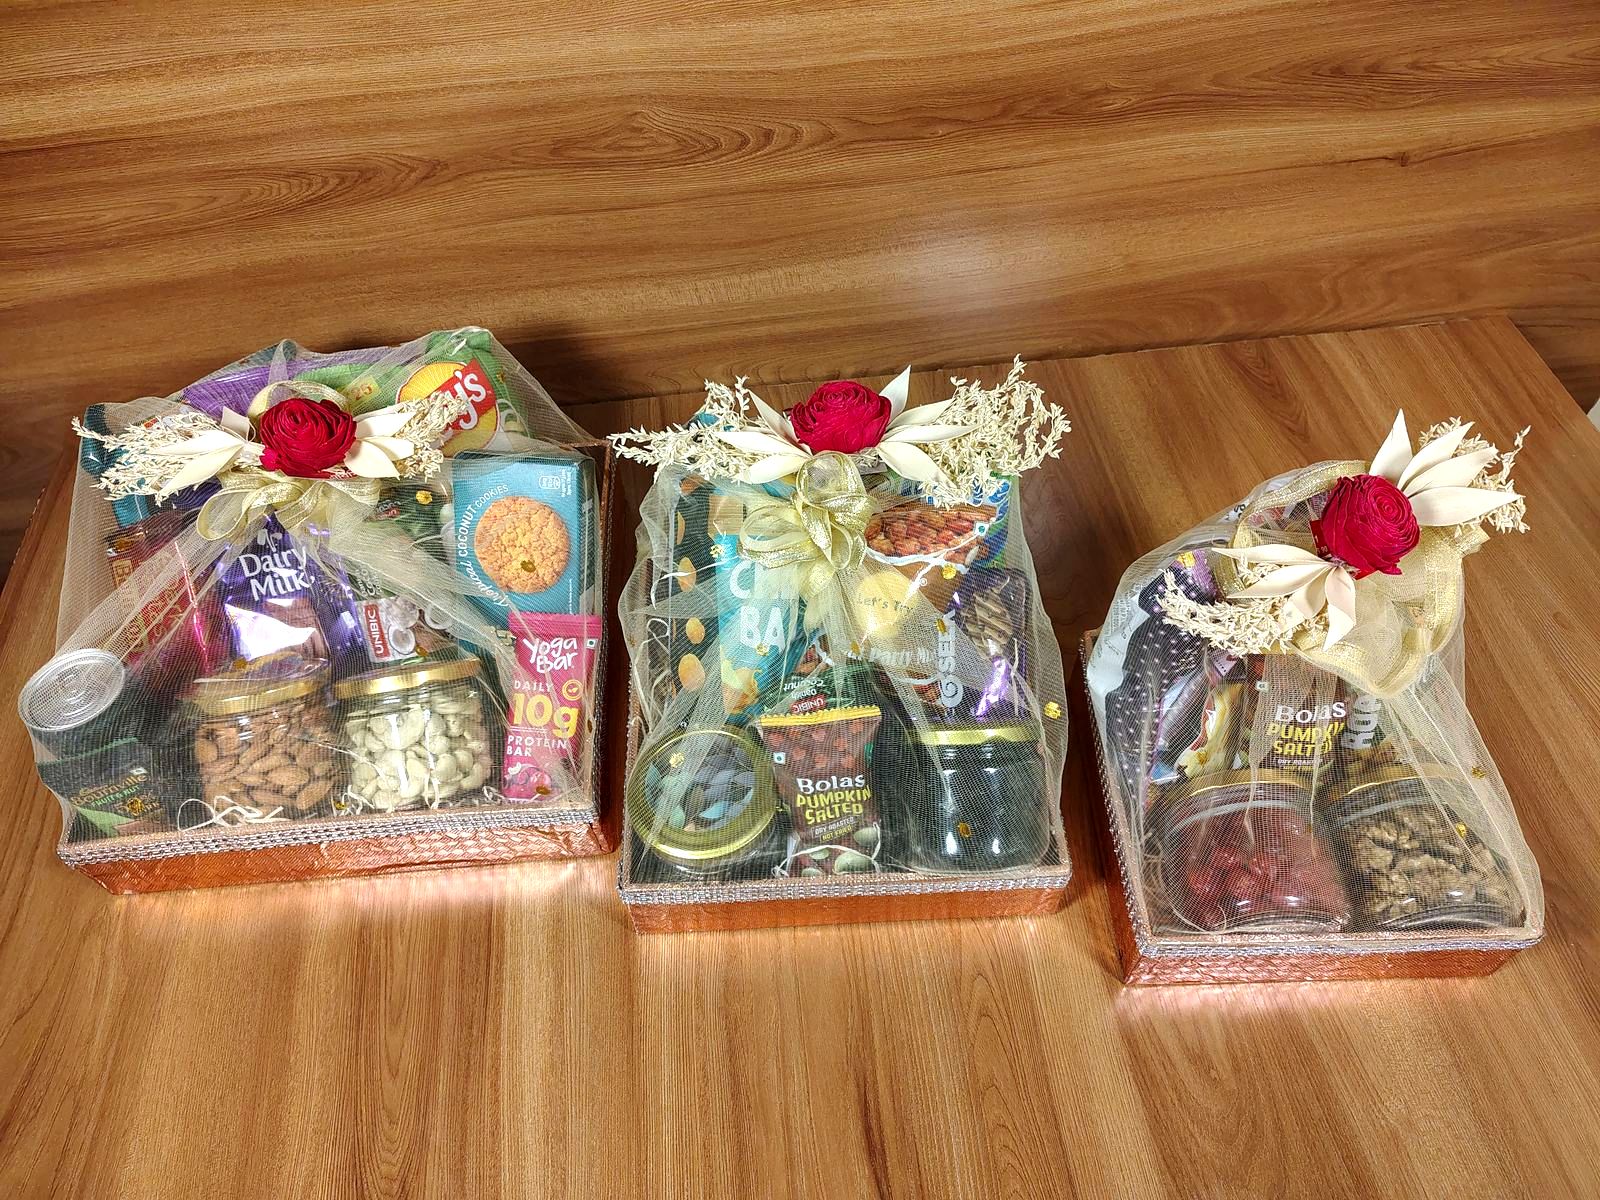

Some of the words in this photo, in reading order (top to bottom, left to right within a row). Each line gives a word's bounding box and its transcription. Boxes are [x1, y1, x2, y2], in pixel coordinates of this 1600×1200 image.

[457, 504, 477, 557] COCONUT
[475, 484, 509, 509] COOKIES
[239, 546, 307, 578] Dairy
[250, 572, 310, 602] Milk
[367, 609, 384, 654] UNIBIC
[523, 637, 578, 664] Yoga
[536, 652, 578, 674] Bar
[514, 680, 554, 692] DAILY
[512, 692, 579, 739] 10g
[792, 698, 824, 713] UNIBIC
[1274, 702, 1347, 724] Bolas
[506, 745, 532, 757] BAR
[507, 734, 567, 749] PROTEIN
[796, 774, 866, 795] Bolas
[796, 784, 872, 808] PUMPKIN
[805, 802, 864, 825] SALTED
